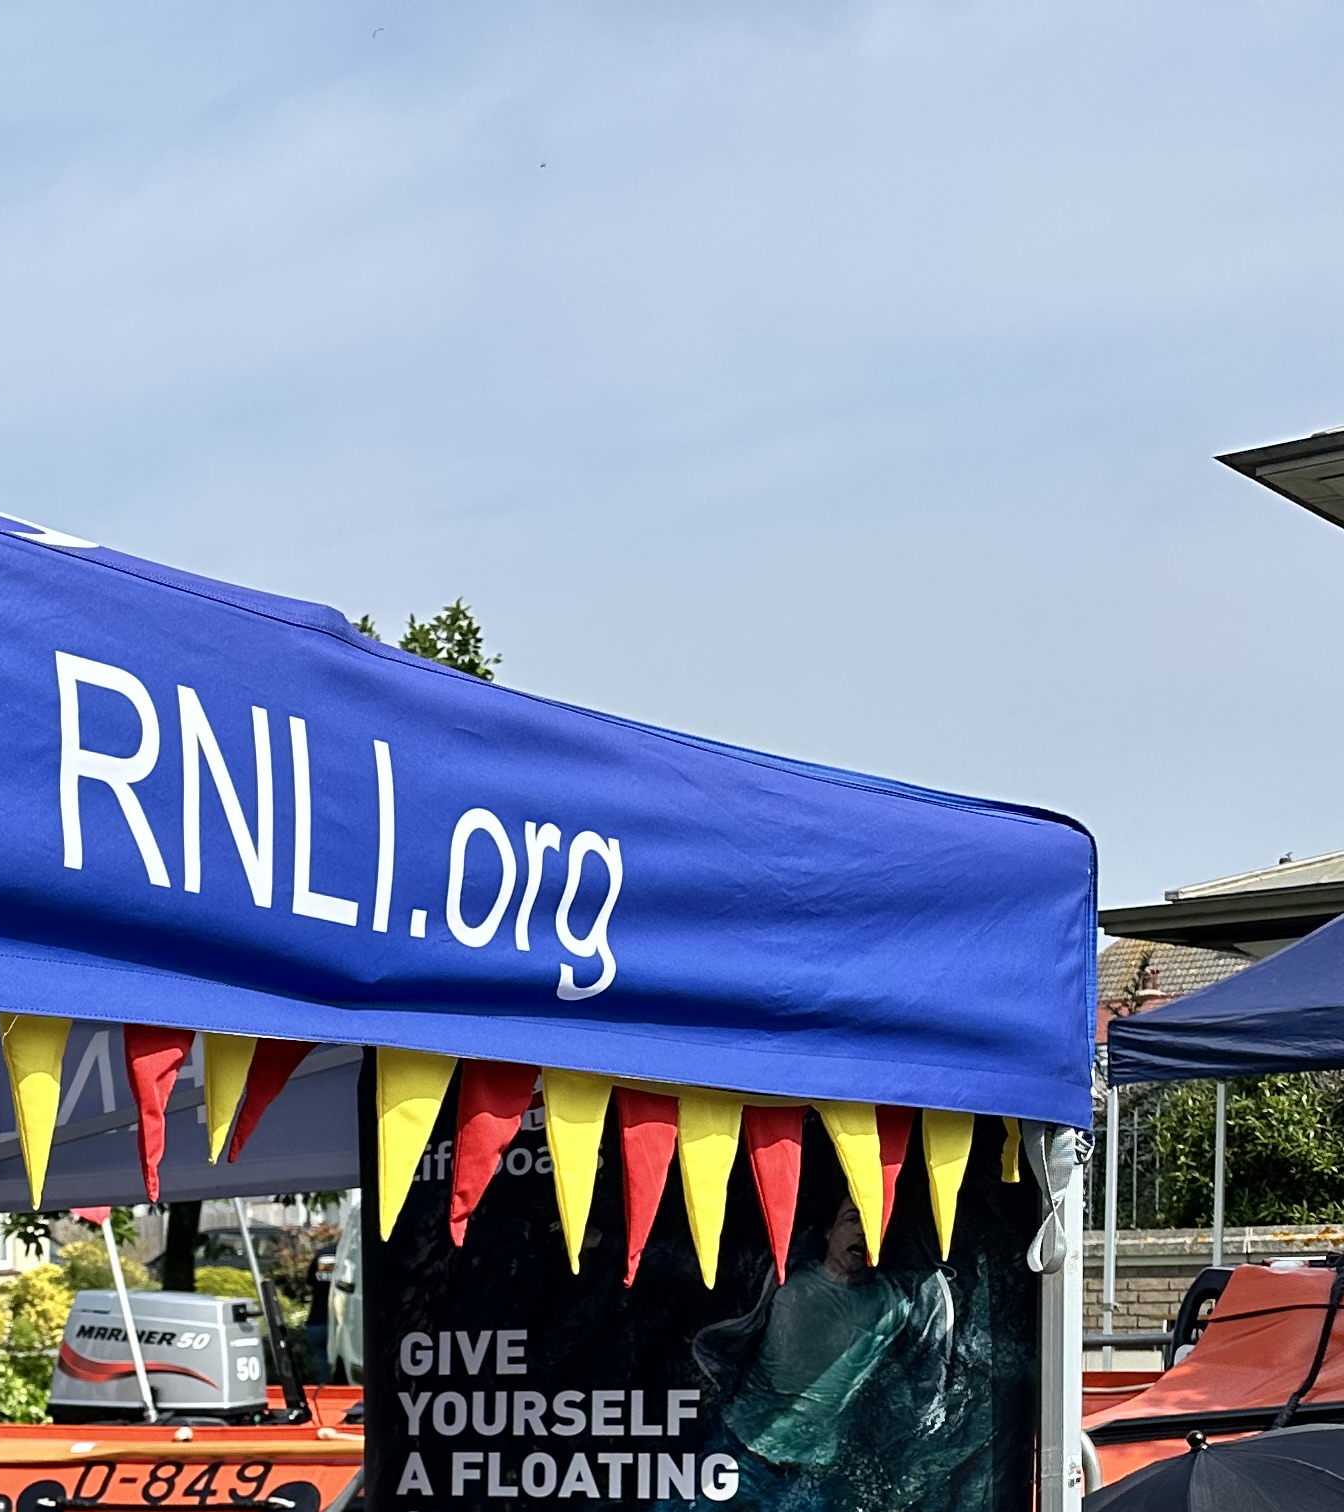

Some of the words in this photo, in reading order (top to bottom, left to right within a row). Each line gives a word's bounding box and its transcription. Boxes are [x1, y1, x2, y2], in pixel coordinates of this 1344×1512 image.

[55, 650, 624, 1001] RNLI.org
[176, 1332, 211, 1350] 50
[399, 1329, 528, 1377] GIVE
[236, 1356, 260, 1382] 50
[398, 1389, 701, 1437] YOURSELF
[72, 1460, 273, 1506] D-849
[396, 1453, 433, 1497] A
[452, 1452, 740, 1502] FLOATING
